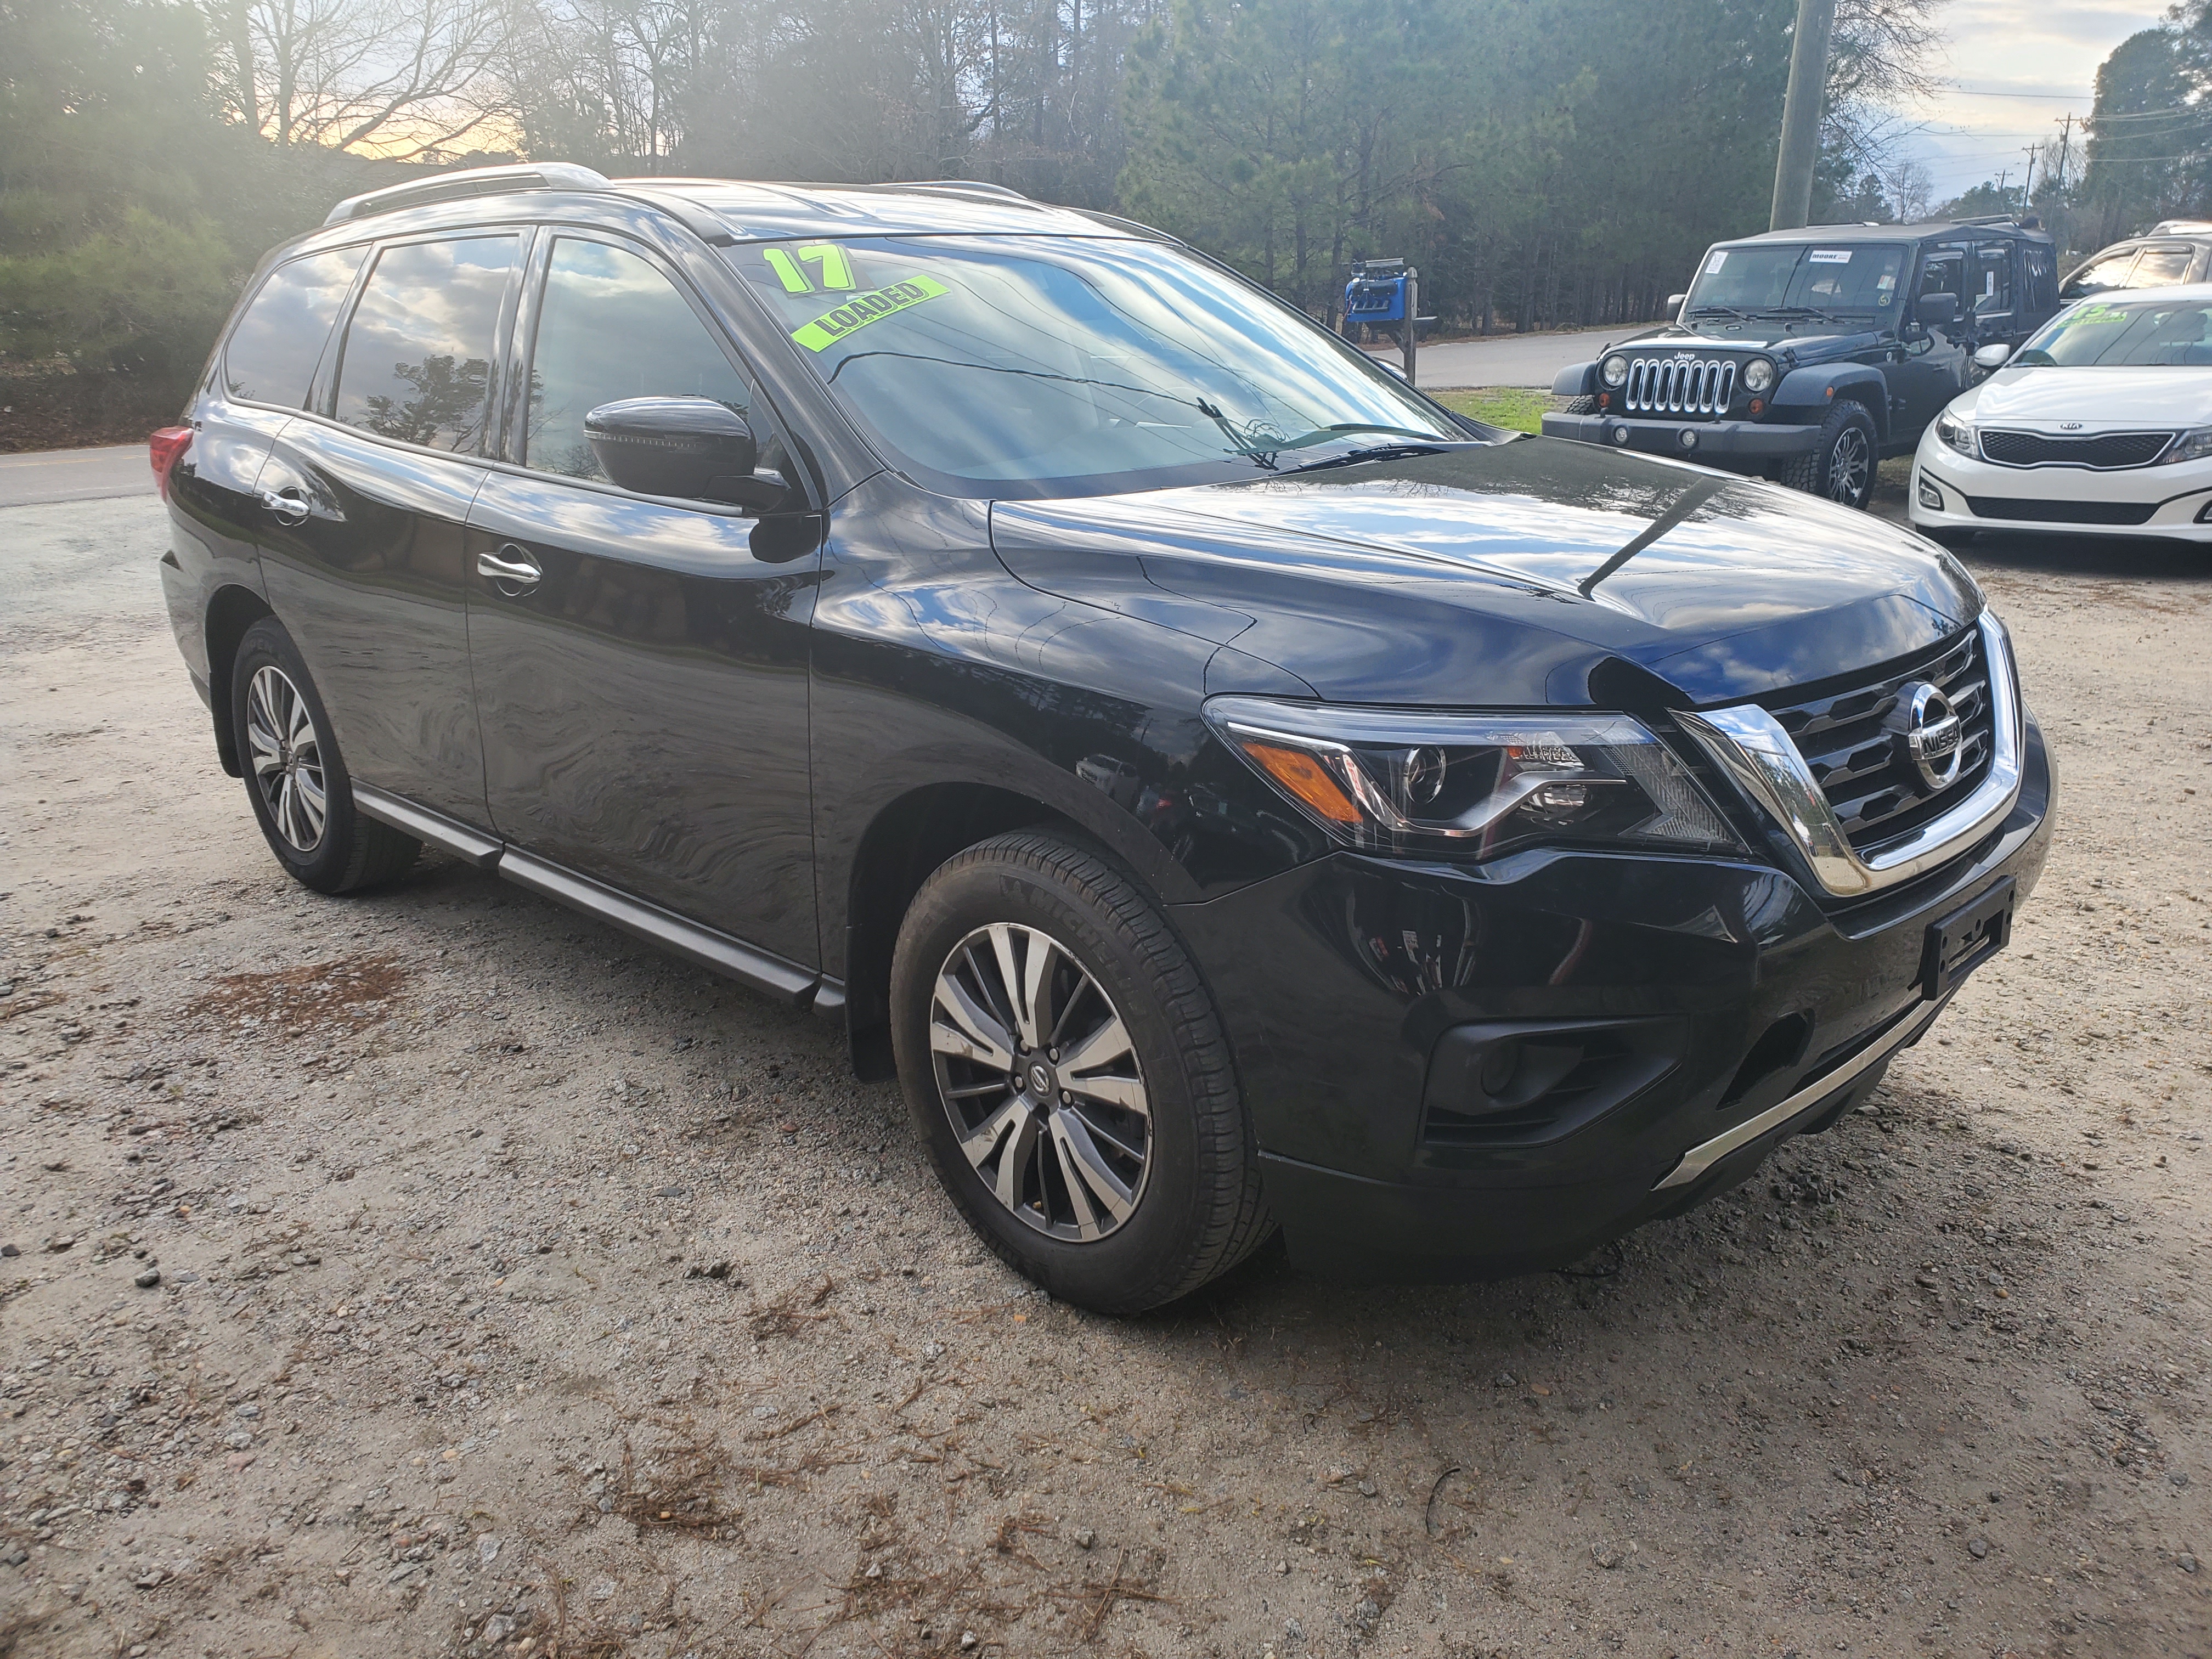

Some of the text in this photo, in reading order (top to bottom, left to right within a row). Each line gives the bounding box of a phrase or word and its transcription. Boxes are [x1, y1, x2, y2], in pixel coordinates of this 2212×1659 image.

[763, 244, 856, 294] 17
[814, 282, 929, 337] LOADED
[2072, 303, 2111, 319] 15
[1674, 352, 1695, 362] Jeep
[1922, 723, 1961, 755] NISSA
[1029, 887, 1148, 1016] MICHELIN
